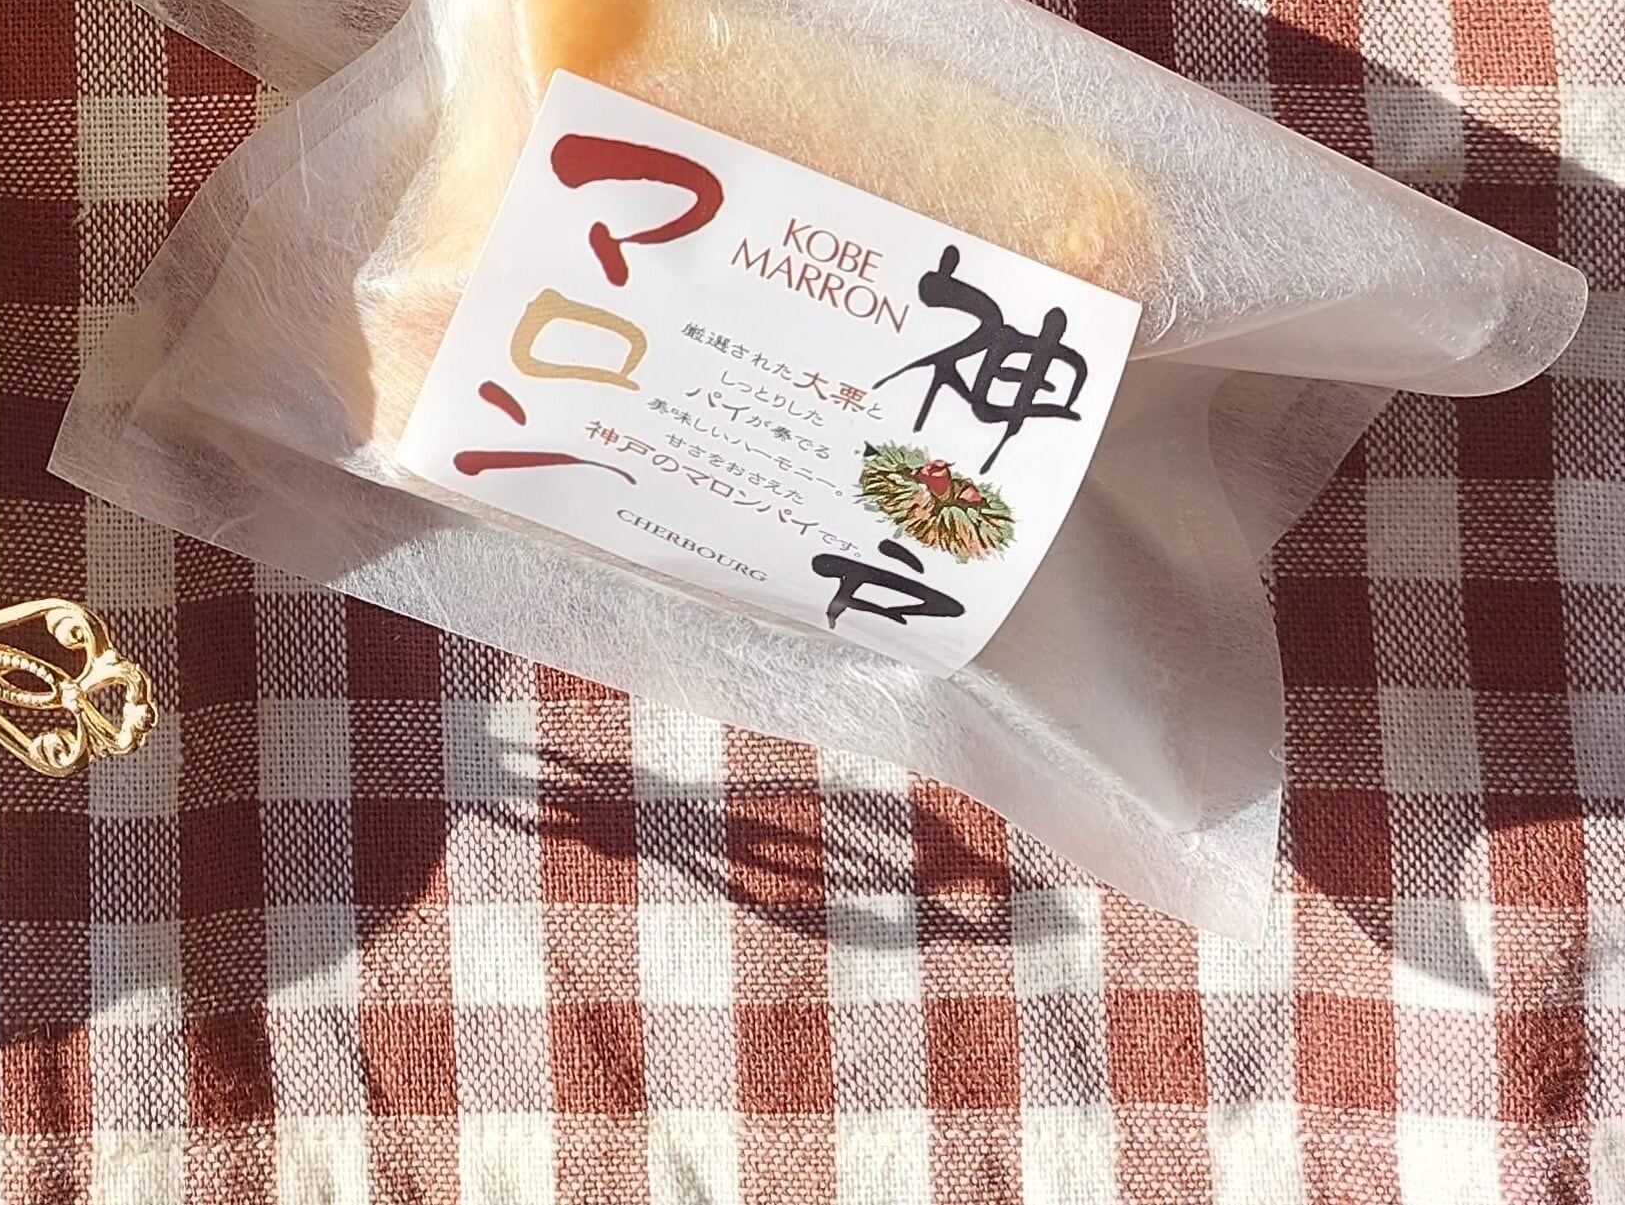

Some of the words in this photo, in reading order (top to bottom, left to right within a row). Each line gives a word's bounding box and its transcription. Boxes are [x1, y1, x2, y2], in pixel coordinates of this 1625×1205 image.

[781, 217, 885, 279] KOBE
[730, 236, 912, 336] MARRON
[680, 321, 884, 421] 厳選された大栗と
[720, 370, 825, 428] しっとりした
[685, 386, 831, 461] パイが奏でる
[584, 419, 863, 559] 神戸のマロンパイです。
[665, 432, 806, 506] 甘さをおさえた
[615, 507, 769, 583] CHERBOURG
